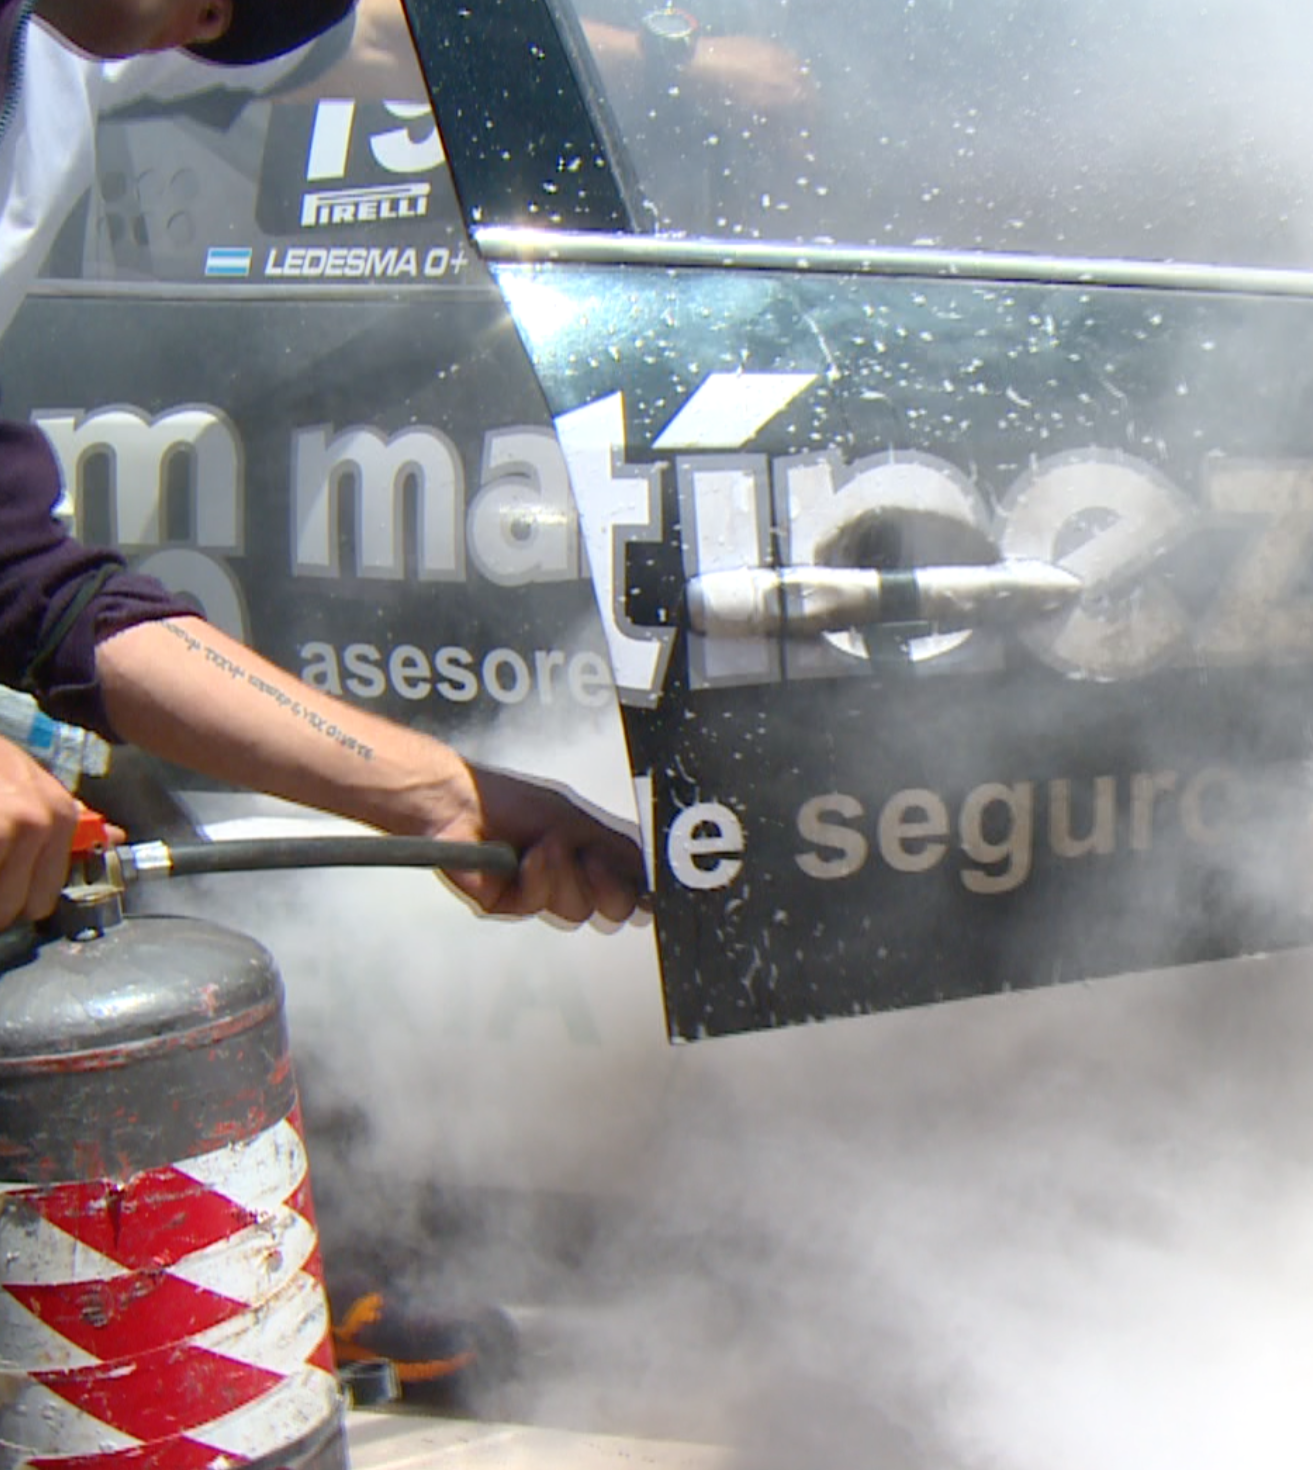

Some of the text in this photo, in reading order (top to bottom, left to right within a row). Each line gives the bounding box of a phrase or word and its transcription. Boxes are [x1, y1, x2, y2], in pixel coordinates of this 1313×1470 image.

[300, 182, 431, 227] PIRELLI
[264, 247, 418, 276] LEDESMA
[632, 772, 746, 890] e
